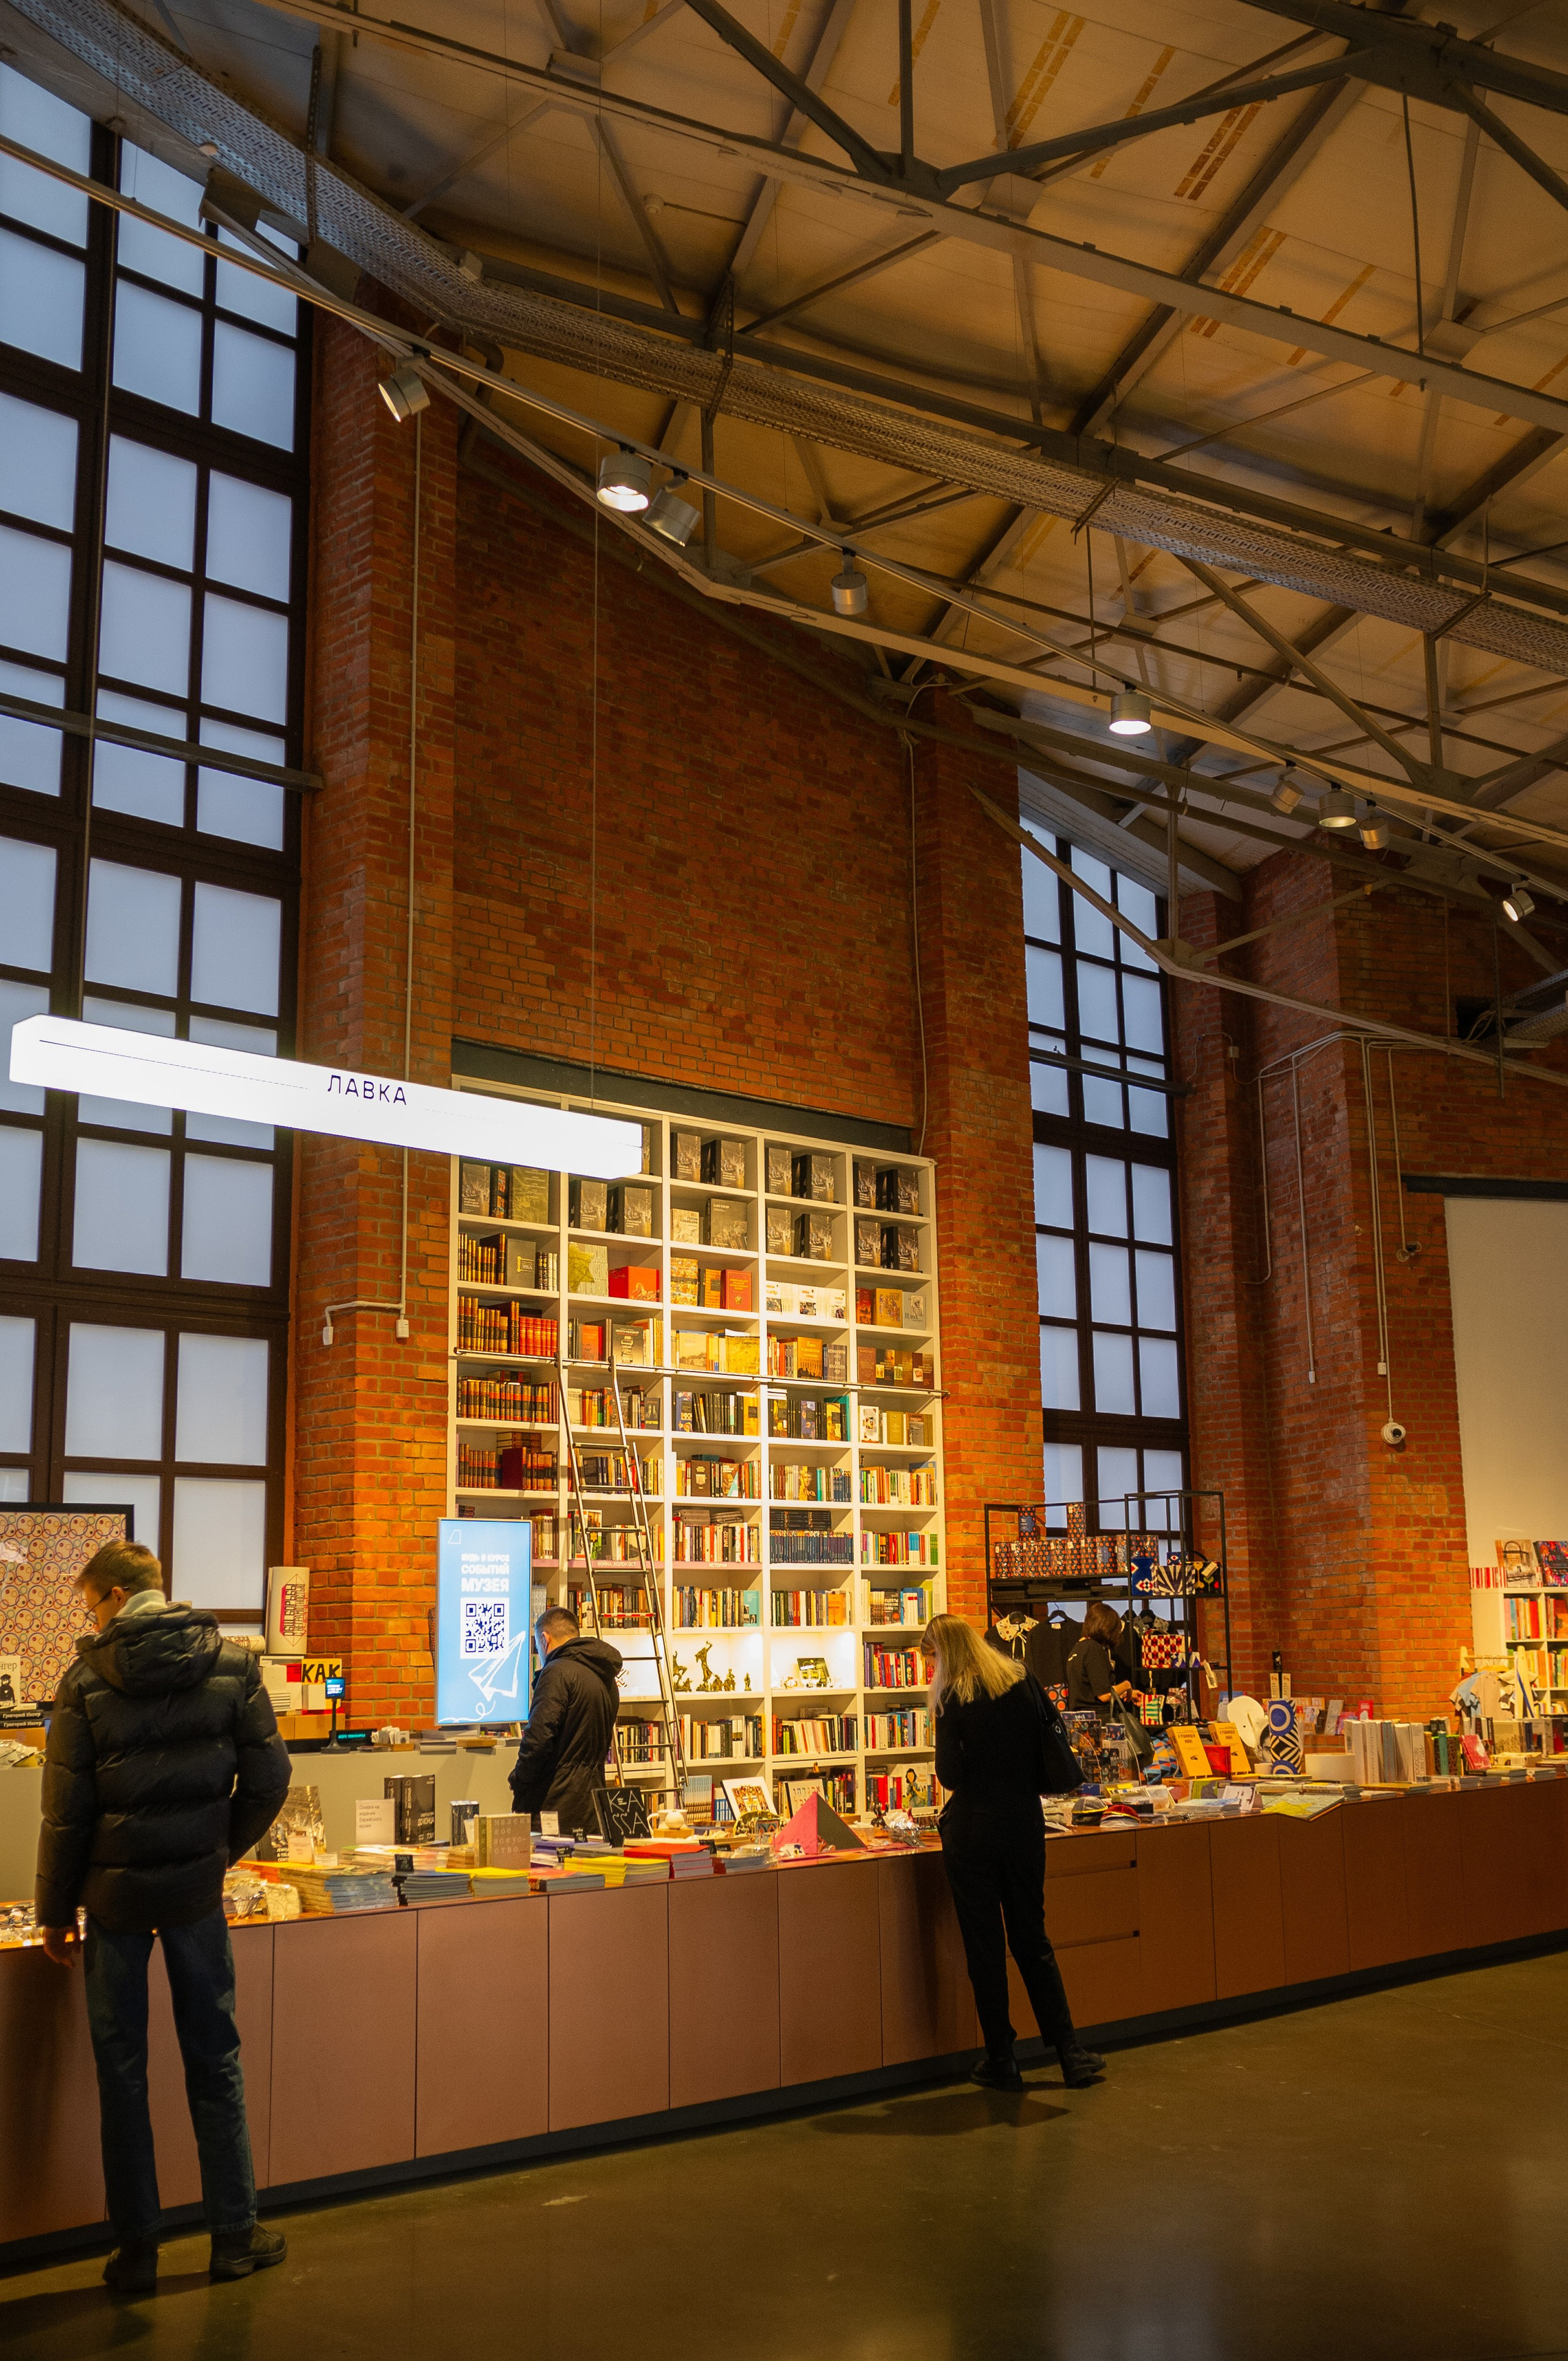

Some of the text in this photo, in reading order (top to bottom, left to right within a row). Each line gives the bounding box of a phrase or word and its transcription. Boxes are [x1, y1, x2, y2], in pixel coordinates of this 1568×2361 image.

[328, 1075, 406, 1105] ЛАВКА
[461, 1562, 510, 1575] СОБЫТИЙ
[461, 1578, 510, 1592] МУЗЕЯ
[302, 1663, 341, 1682] КАК
